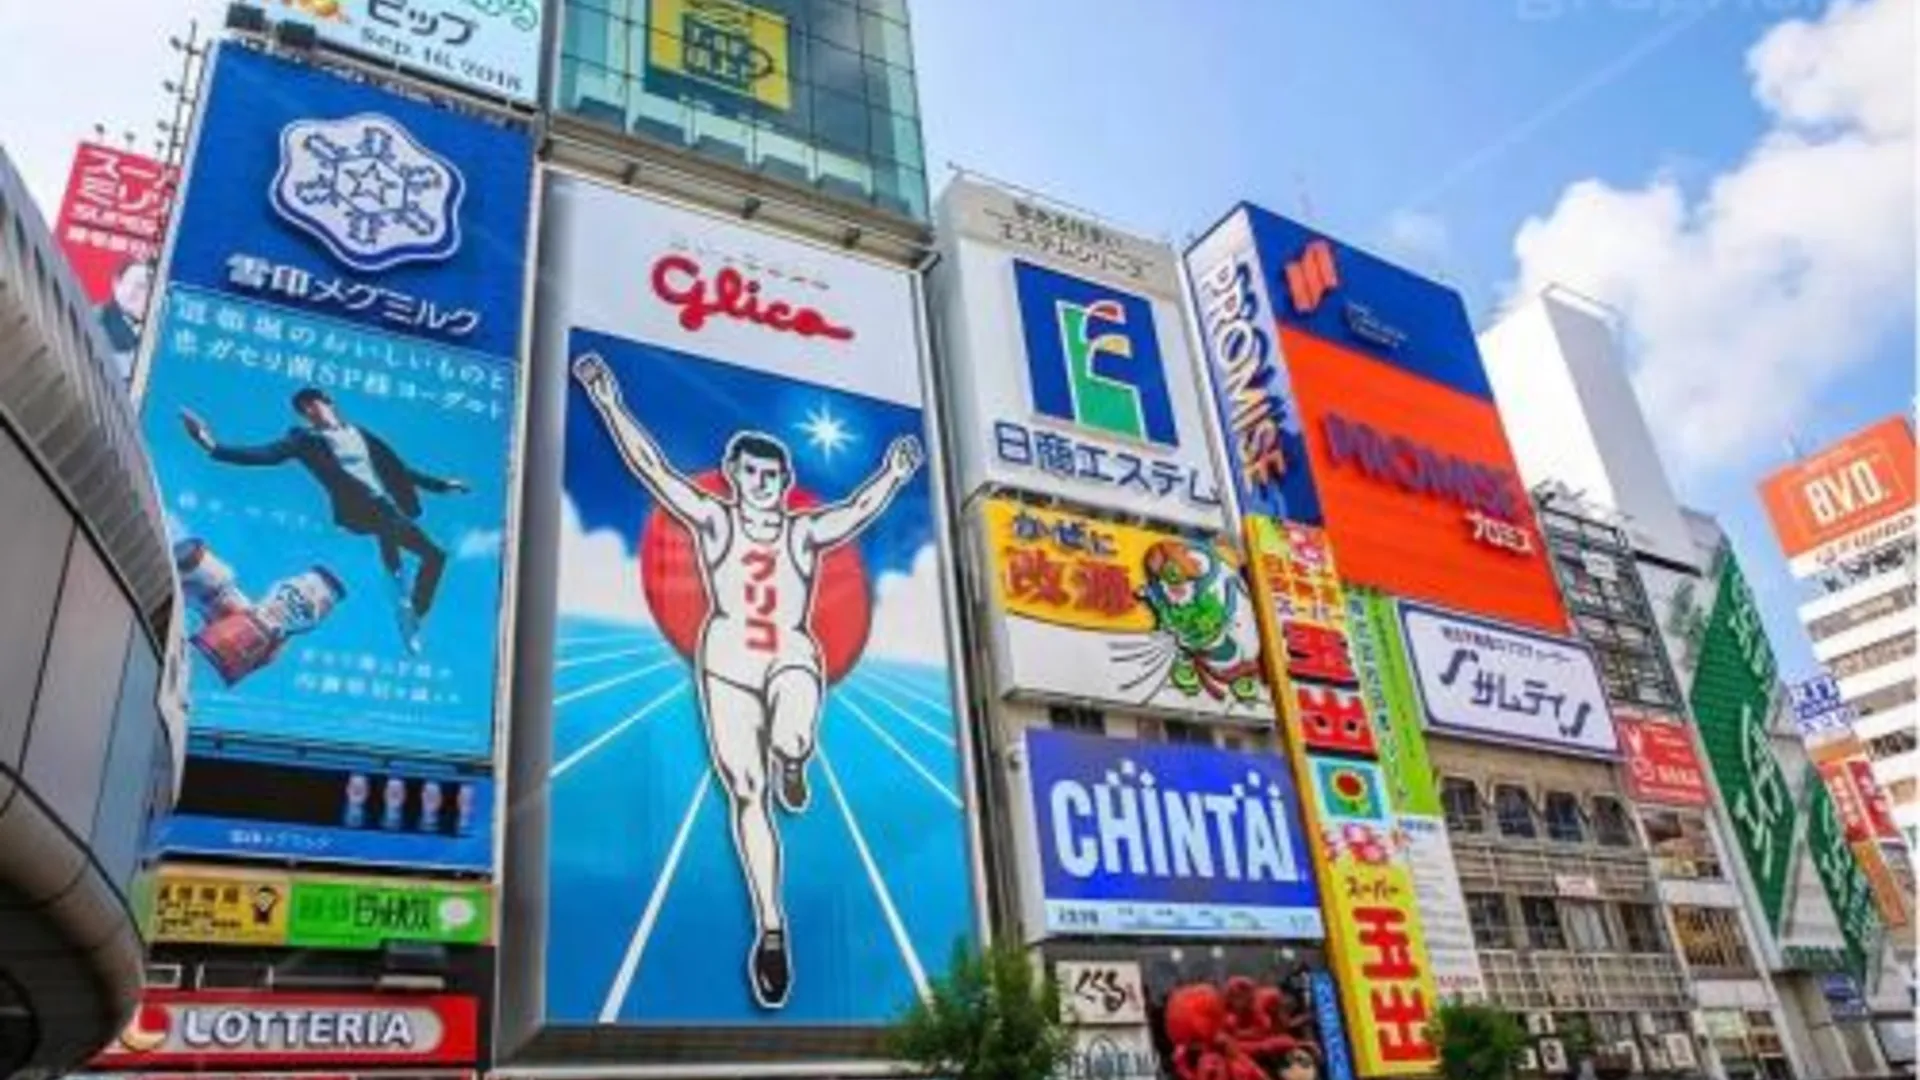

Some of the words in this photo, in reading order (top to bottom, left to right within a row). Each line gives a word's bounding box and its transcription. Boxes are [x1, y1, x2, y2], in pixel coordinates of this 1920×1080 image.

[225, 252, 482, 335] 雪印メグミルク
[652, 255, 854, 331] Glico
[1325, 410, 1516, 522] PROMISE
[739, 549, 780, 653] グリコ
[1051, 760, 1299, 882] CHINTAI
[182, 1009, 415, 1049] LOTTERIA
[1350, 906, 1438, 1062] 玉出
